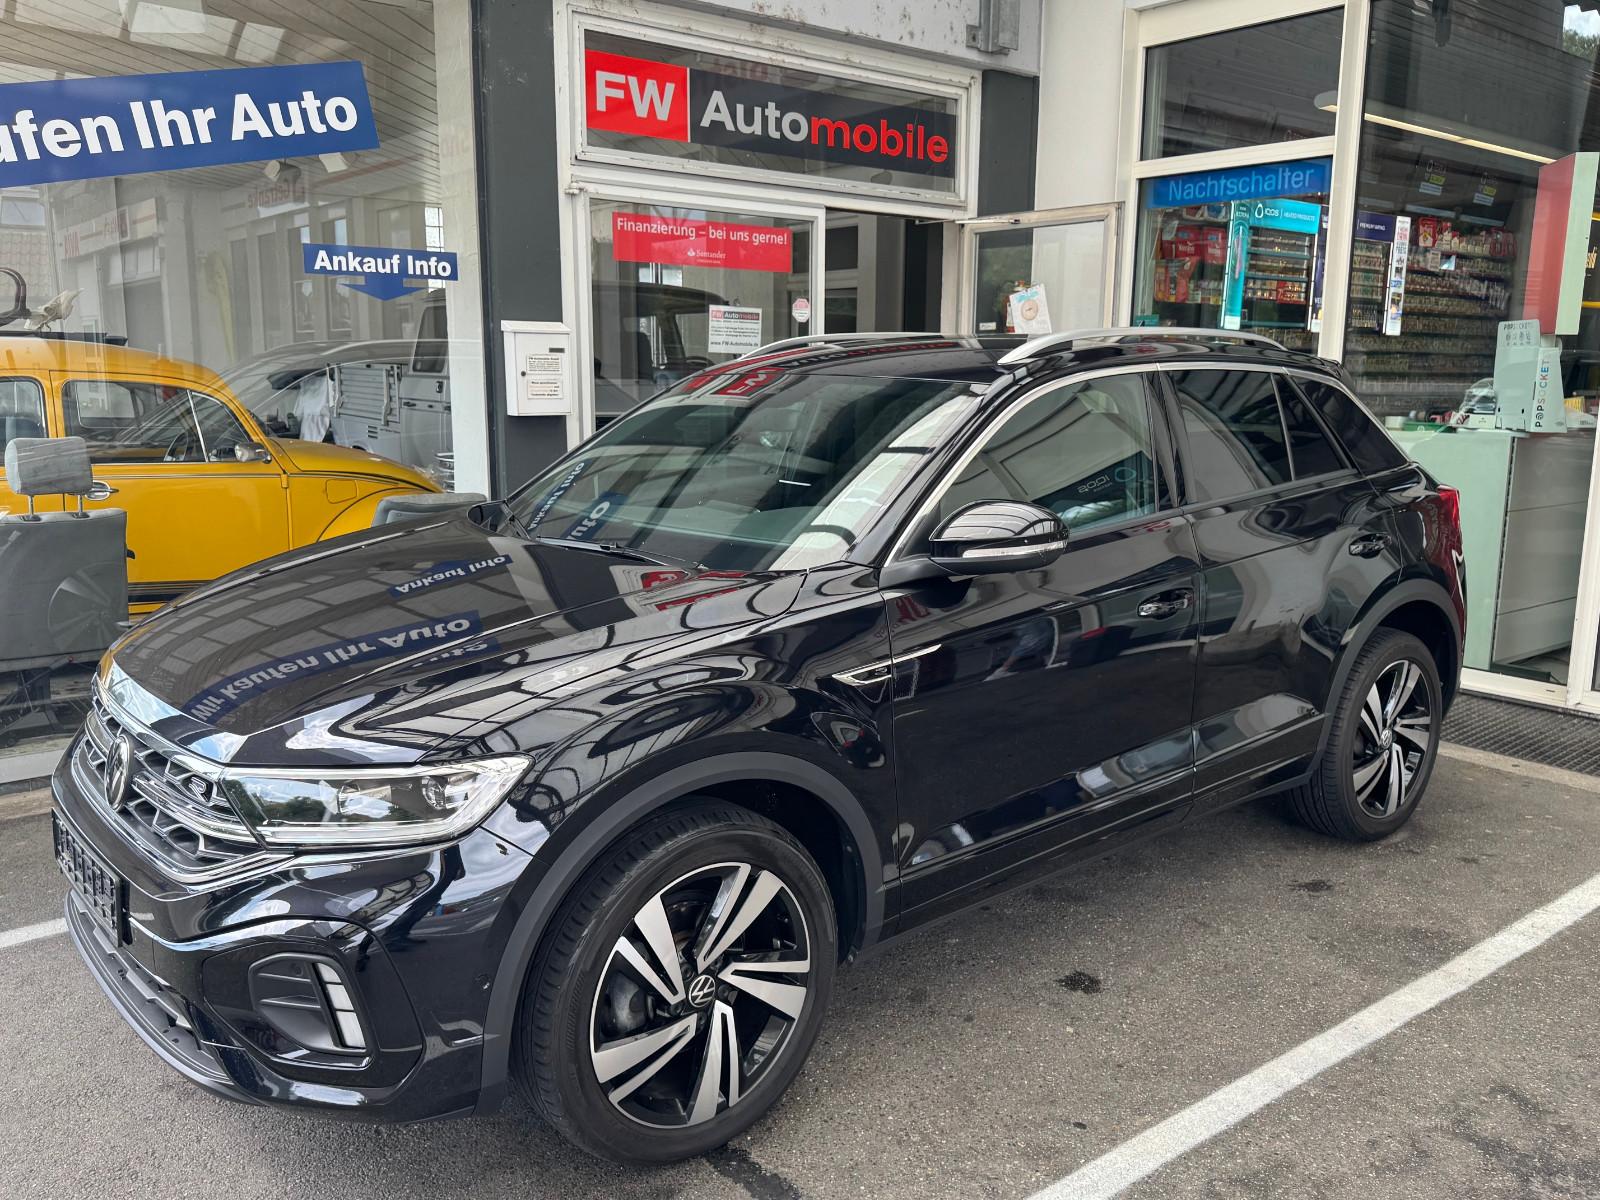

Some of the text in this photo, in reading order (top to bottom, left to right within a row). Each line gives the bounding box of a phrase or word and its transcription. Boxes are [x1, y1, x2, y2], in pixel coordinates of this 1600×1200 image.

[129, 98, 217, 149] Ihr
[231, 90, 358, 142] Auto
[595, 70, 949, 163] FW Automobile
[1168, 167, 1315, 201] Nachtschalter
[616, 217, 697, 240] Finanzierung
[708, 225, 727, 240] bei
[730, 231, 750, 242] uns
[752, 232, 788, 246] gerne!
[314, 250, 452, 277] Ankauf Info
[695, 249, 727, 260] Santander
[724, 312, 759, 320] Automobile
